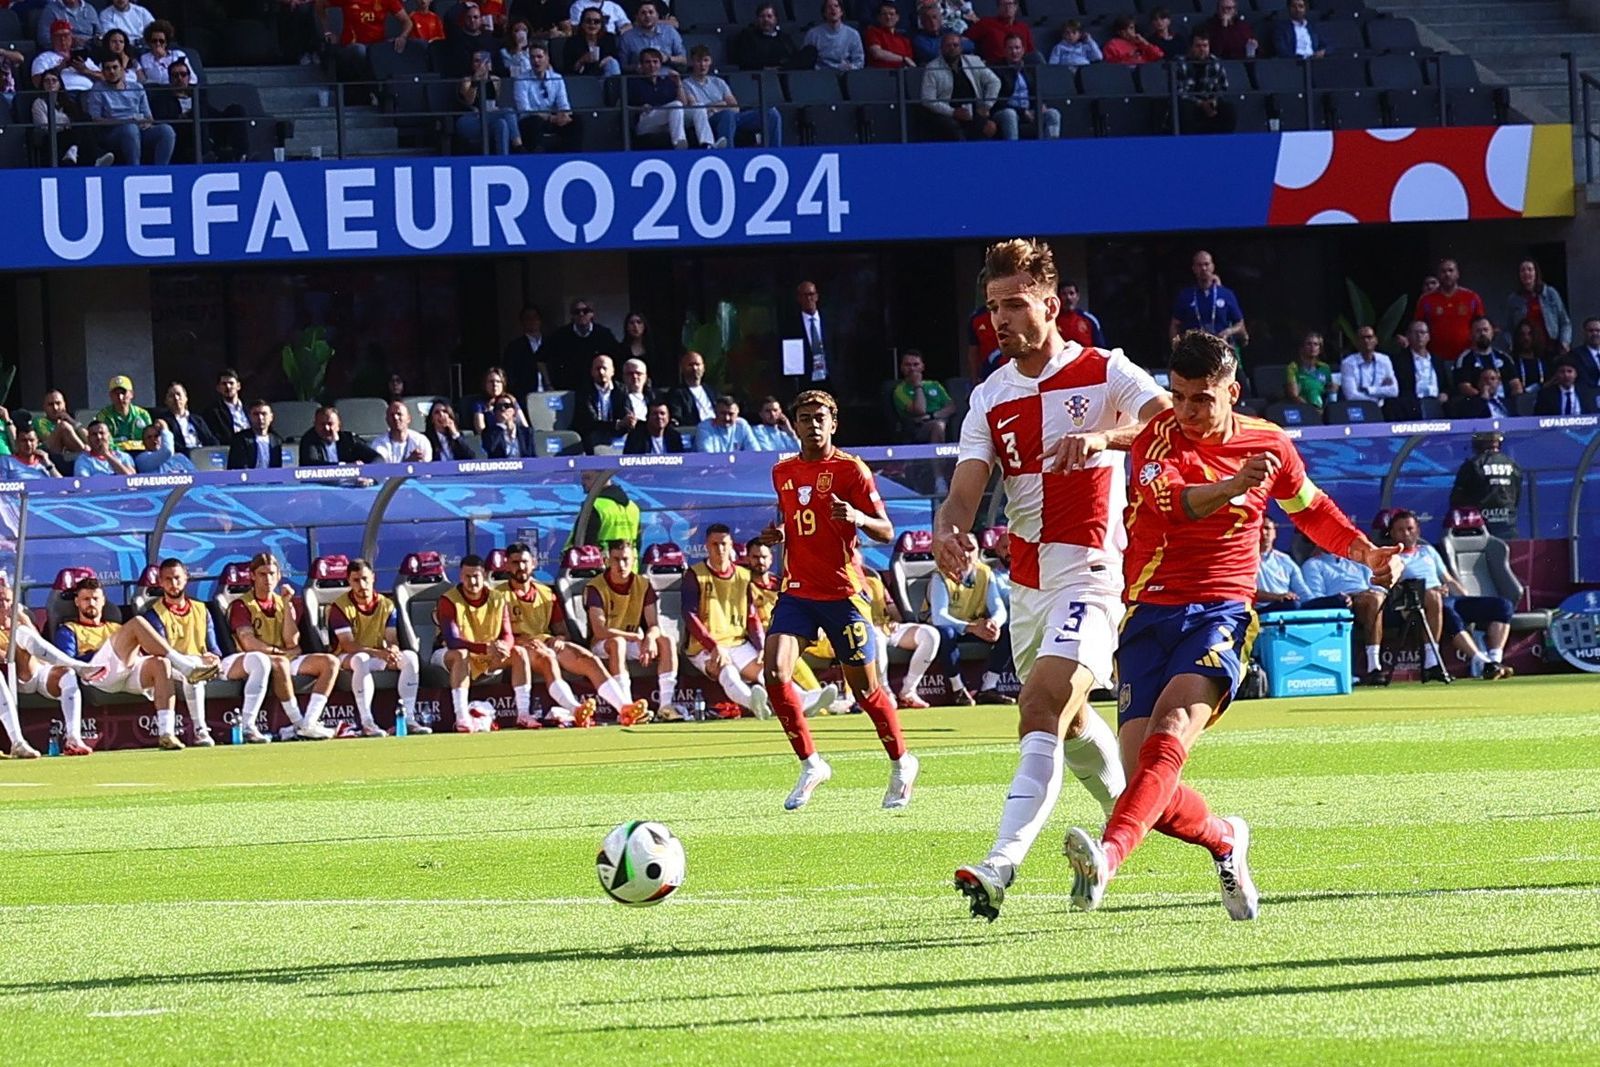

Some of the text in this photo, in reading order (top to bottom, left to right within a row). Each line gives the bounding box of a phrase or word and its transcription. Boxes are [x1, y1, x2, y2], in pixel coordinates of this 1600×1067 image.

[1001, 432, 1021, 468] 3
[1483, 464, 1513, 475] BEST
[793, 509, 816, 535] 19
[1225, 507, 1248, 538] 7
[1063, 602, 1089, 632] 3
[843, 622, 867, 650] 19
